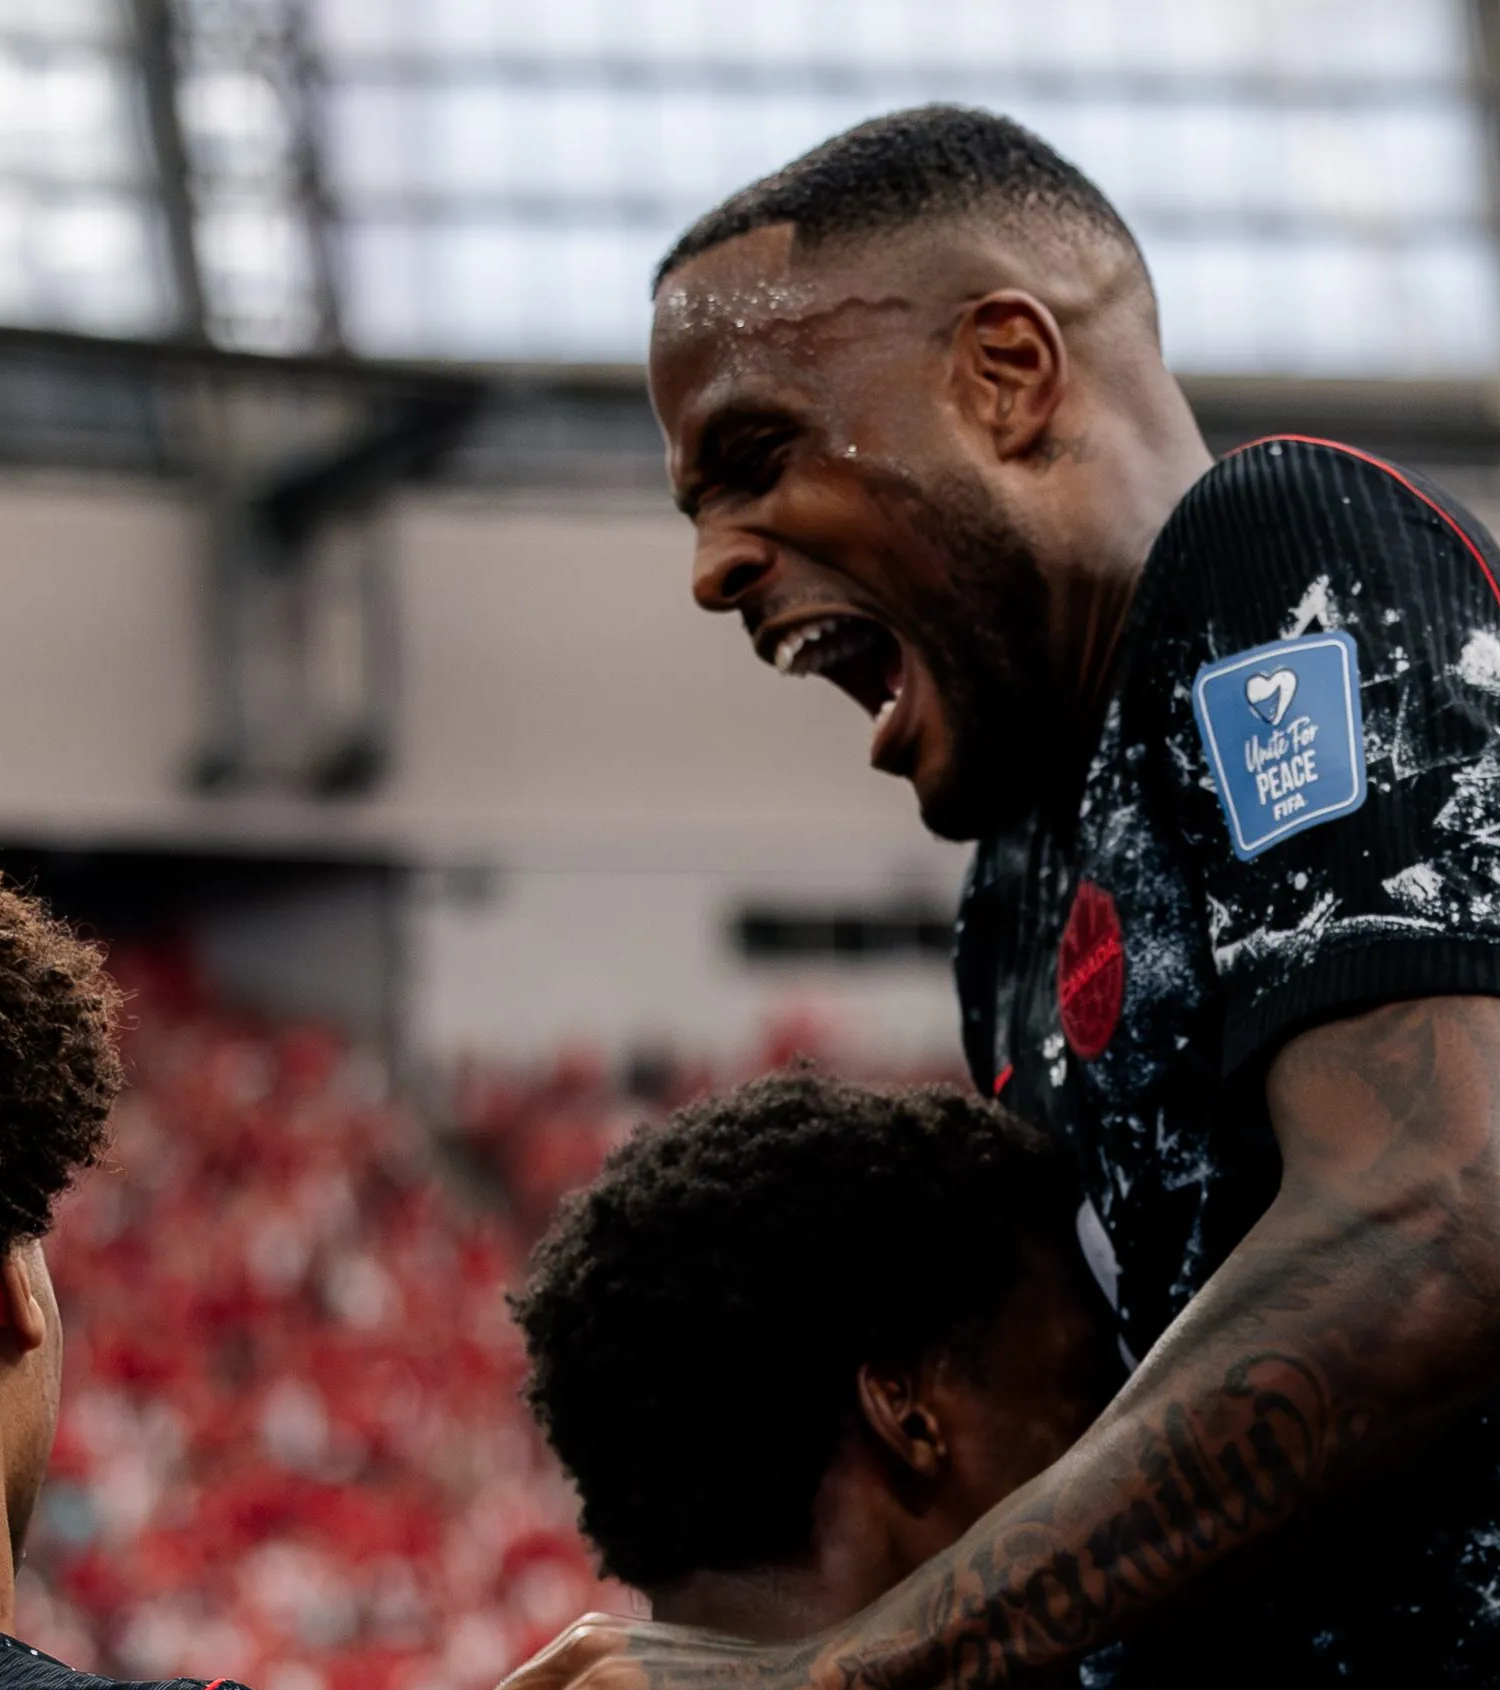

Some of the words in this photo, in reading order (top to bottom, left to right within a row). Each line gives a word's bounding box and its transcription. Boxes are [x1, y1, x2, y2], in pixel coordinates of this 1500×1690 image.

[1245, 730, 1289, 773] Unite
[1287, 716, 1318, 753] For
[1256, 750, 1318, 805] PEACE
[1273, 792, 1306, 820] FIFA
